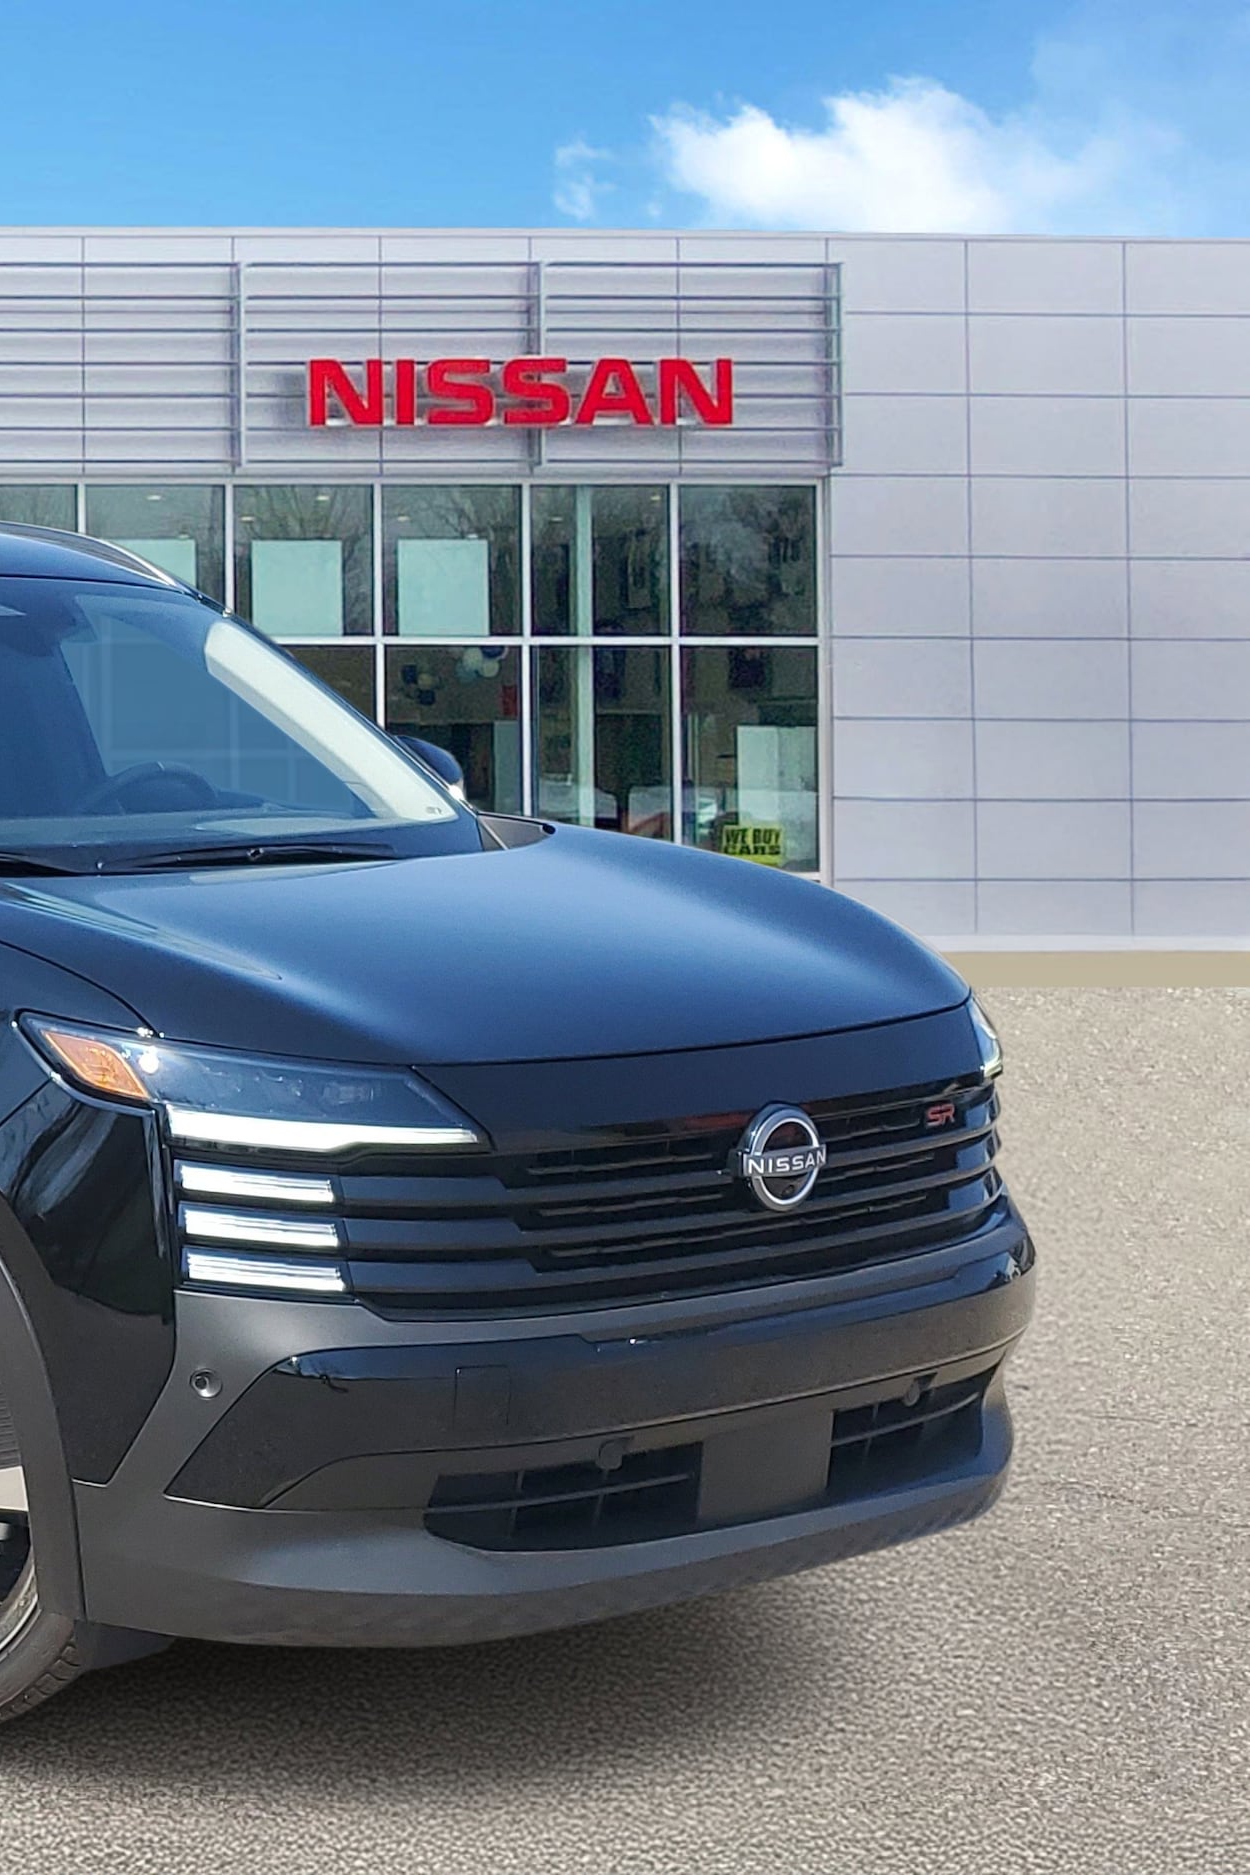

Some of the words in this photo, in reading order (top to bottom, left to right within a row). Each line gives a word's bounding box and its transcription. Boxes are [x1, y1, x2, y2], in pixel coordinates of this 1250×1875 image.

[307, 357, 734, 427] NISSAN
[725, 827, 748, 844] WE
[752, 827, 781, 845] BUY
[724, 844, 781, 856] CARS
[926, 1102, 955, 1127] SR
[748, 1148, 827, 1175] NISSAN
